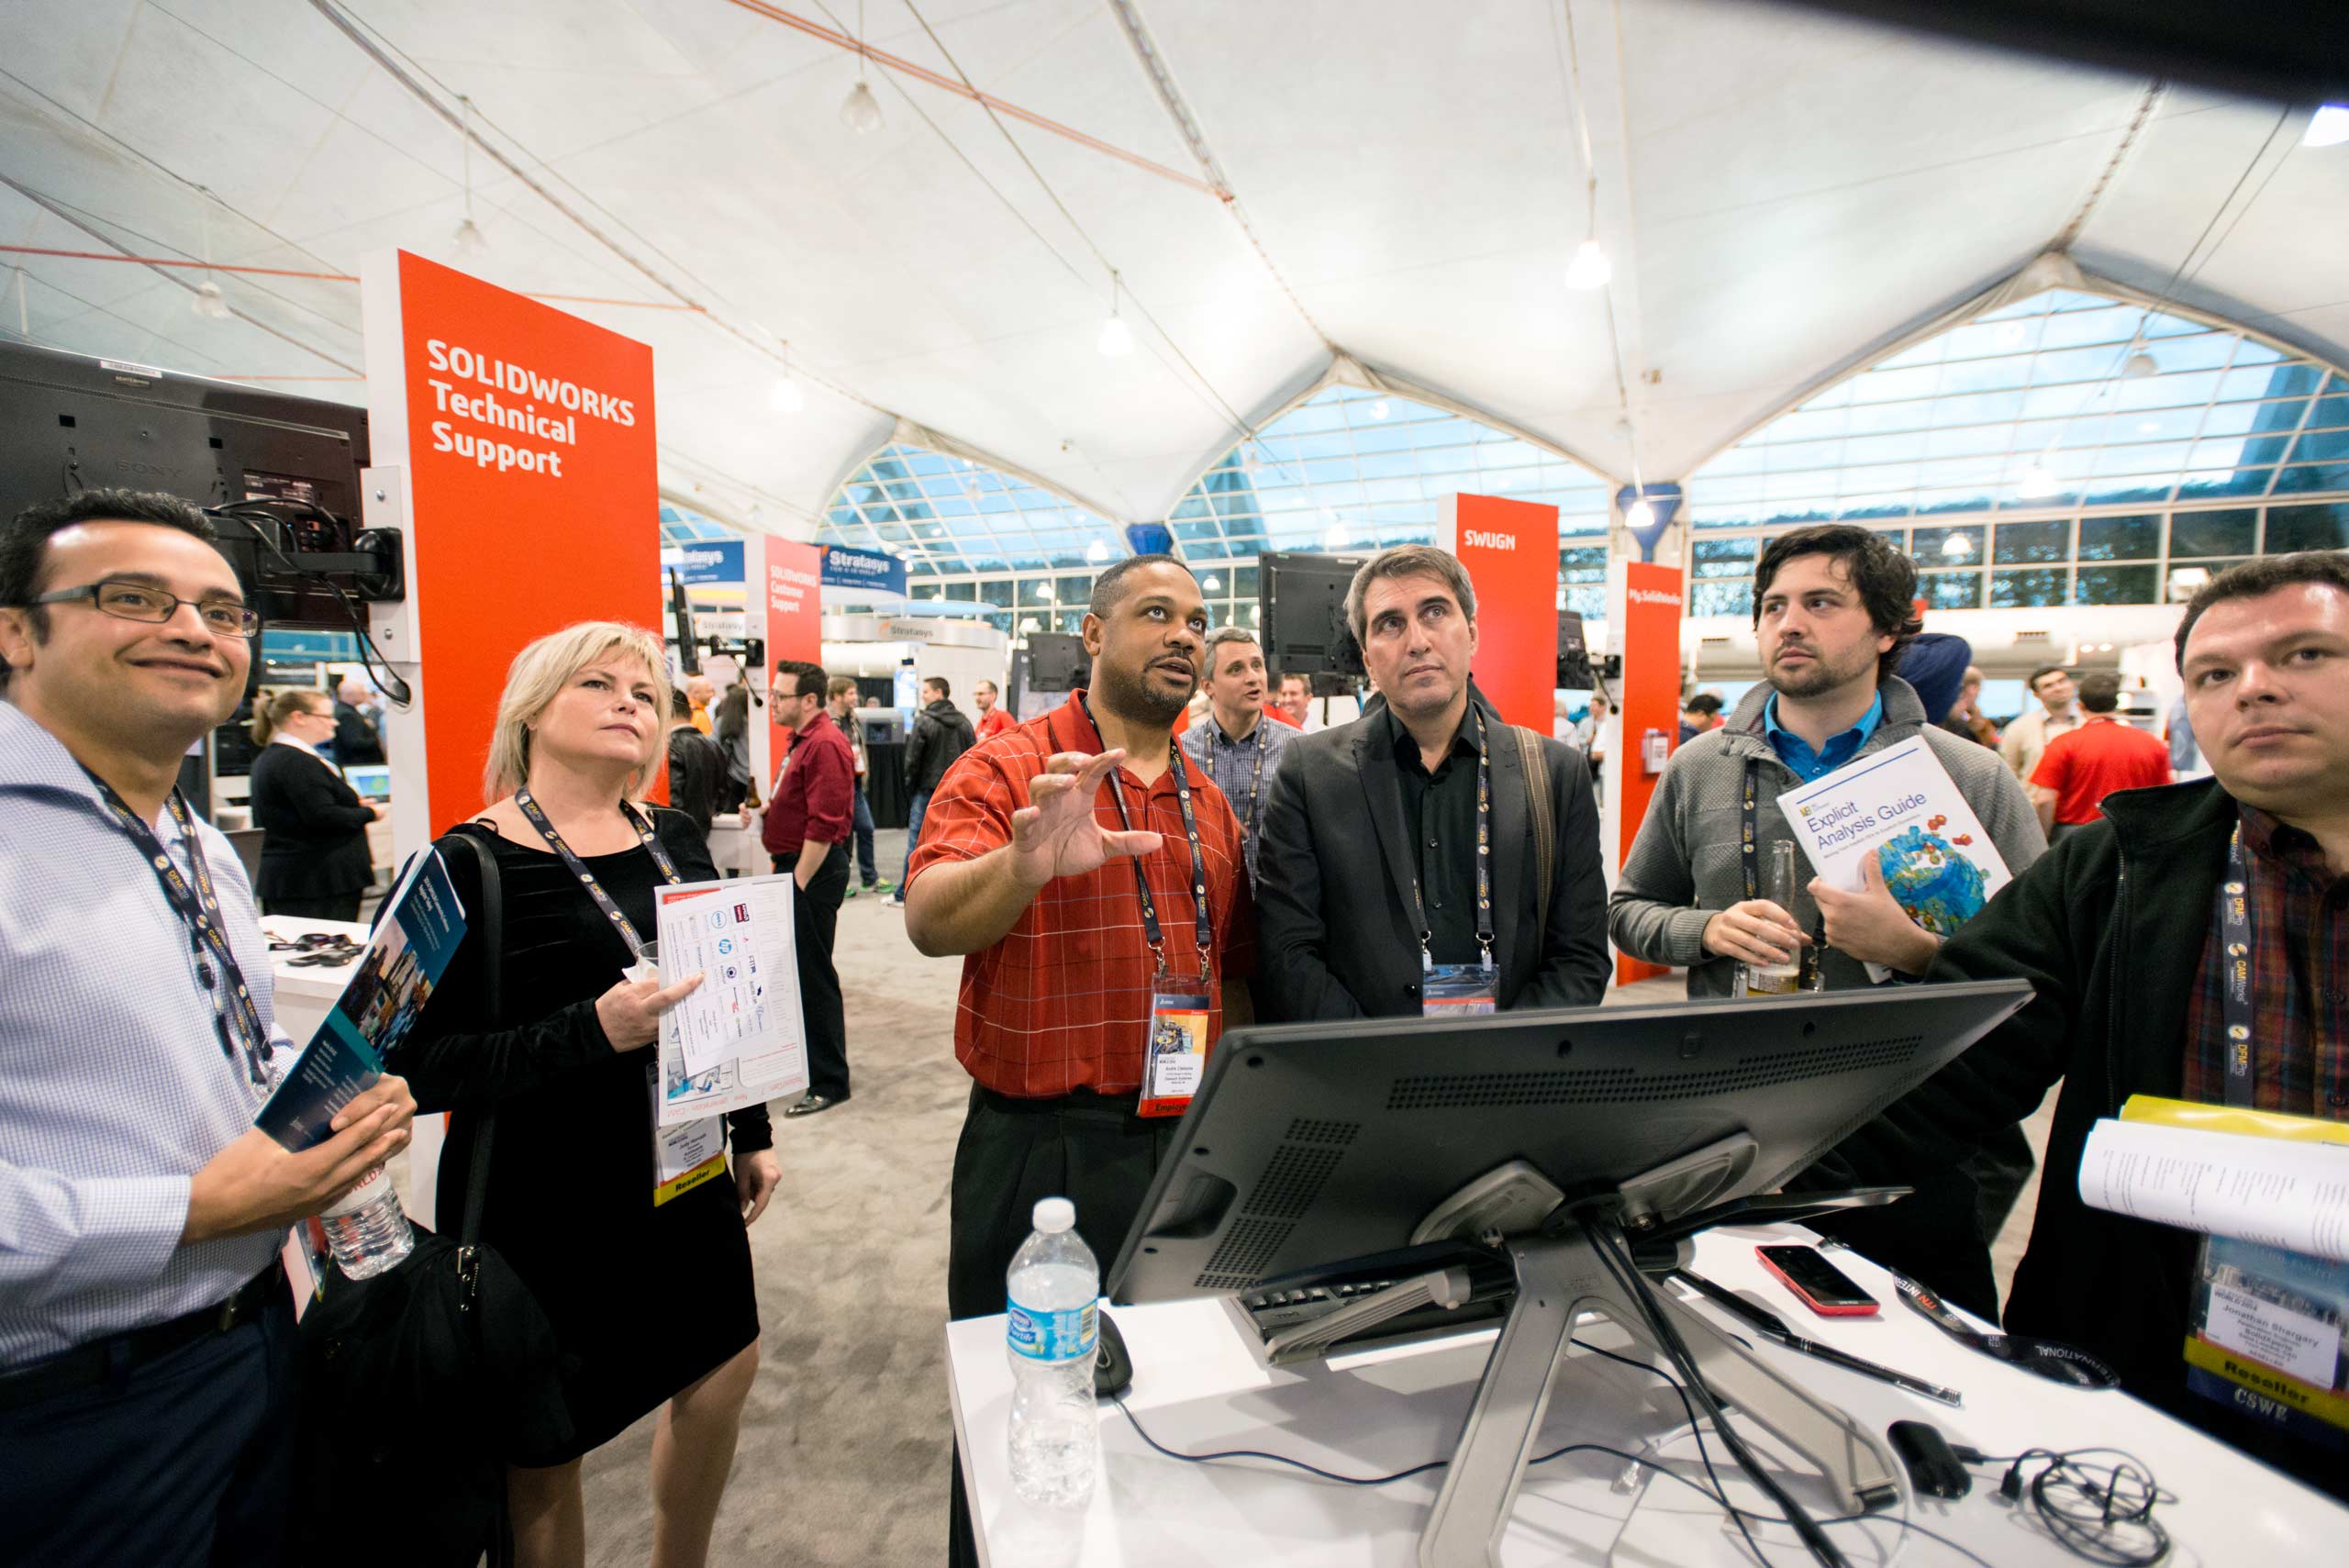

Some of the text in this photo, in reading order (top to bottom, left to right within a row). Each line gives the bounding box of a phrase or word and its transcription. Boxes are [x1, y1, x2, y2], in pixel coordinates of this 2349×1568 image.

[427, 339, 636, 427] SOLIDWORKS
[429, 379, 576, 445] Technical
[431, 421, 562, 478] Support
[1464, 528, 1516, 551] SWUGN
[829, 550, 890, 573] Stratasys
[770, 565, 818, 588] SOLIDWORKS
[770, 580, 805, 599] Customer
[770, 595, 800, 613] Support
[703, 620, 744, 633] Stratasy
[890, 625, 934, 639] Stratasys
[1807, 801, 1859, 833] Explicit
[1817, 793, 1928, 850] Analysis Guide
[2234, 897, 2244, 926] DFMPro
[2236, 960, 2248, 1005] CAMWorks
[2236, 1044, 2247, 1076] DFMPro
[1155, 1099, 1188, 1113] Employe
[675, 1169, 710, 1192] Reseller
[1919, 1294, 1937, 1310] ITN
[2223, 1306, 2268, 1327] Jonathan
[2034, 1344, 2121, 1387] TERNATIONAL
[2224, 1360, 2309, 1403] Reseller
[2234, 1387, 2288, 1421] CSWE
